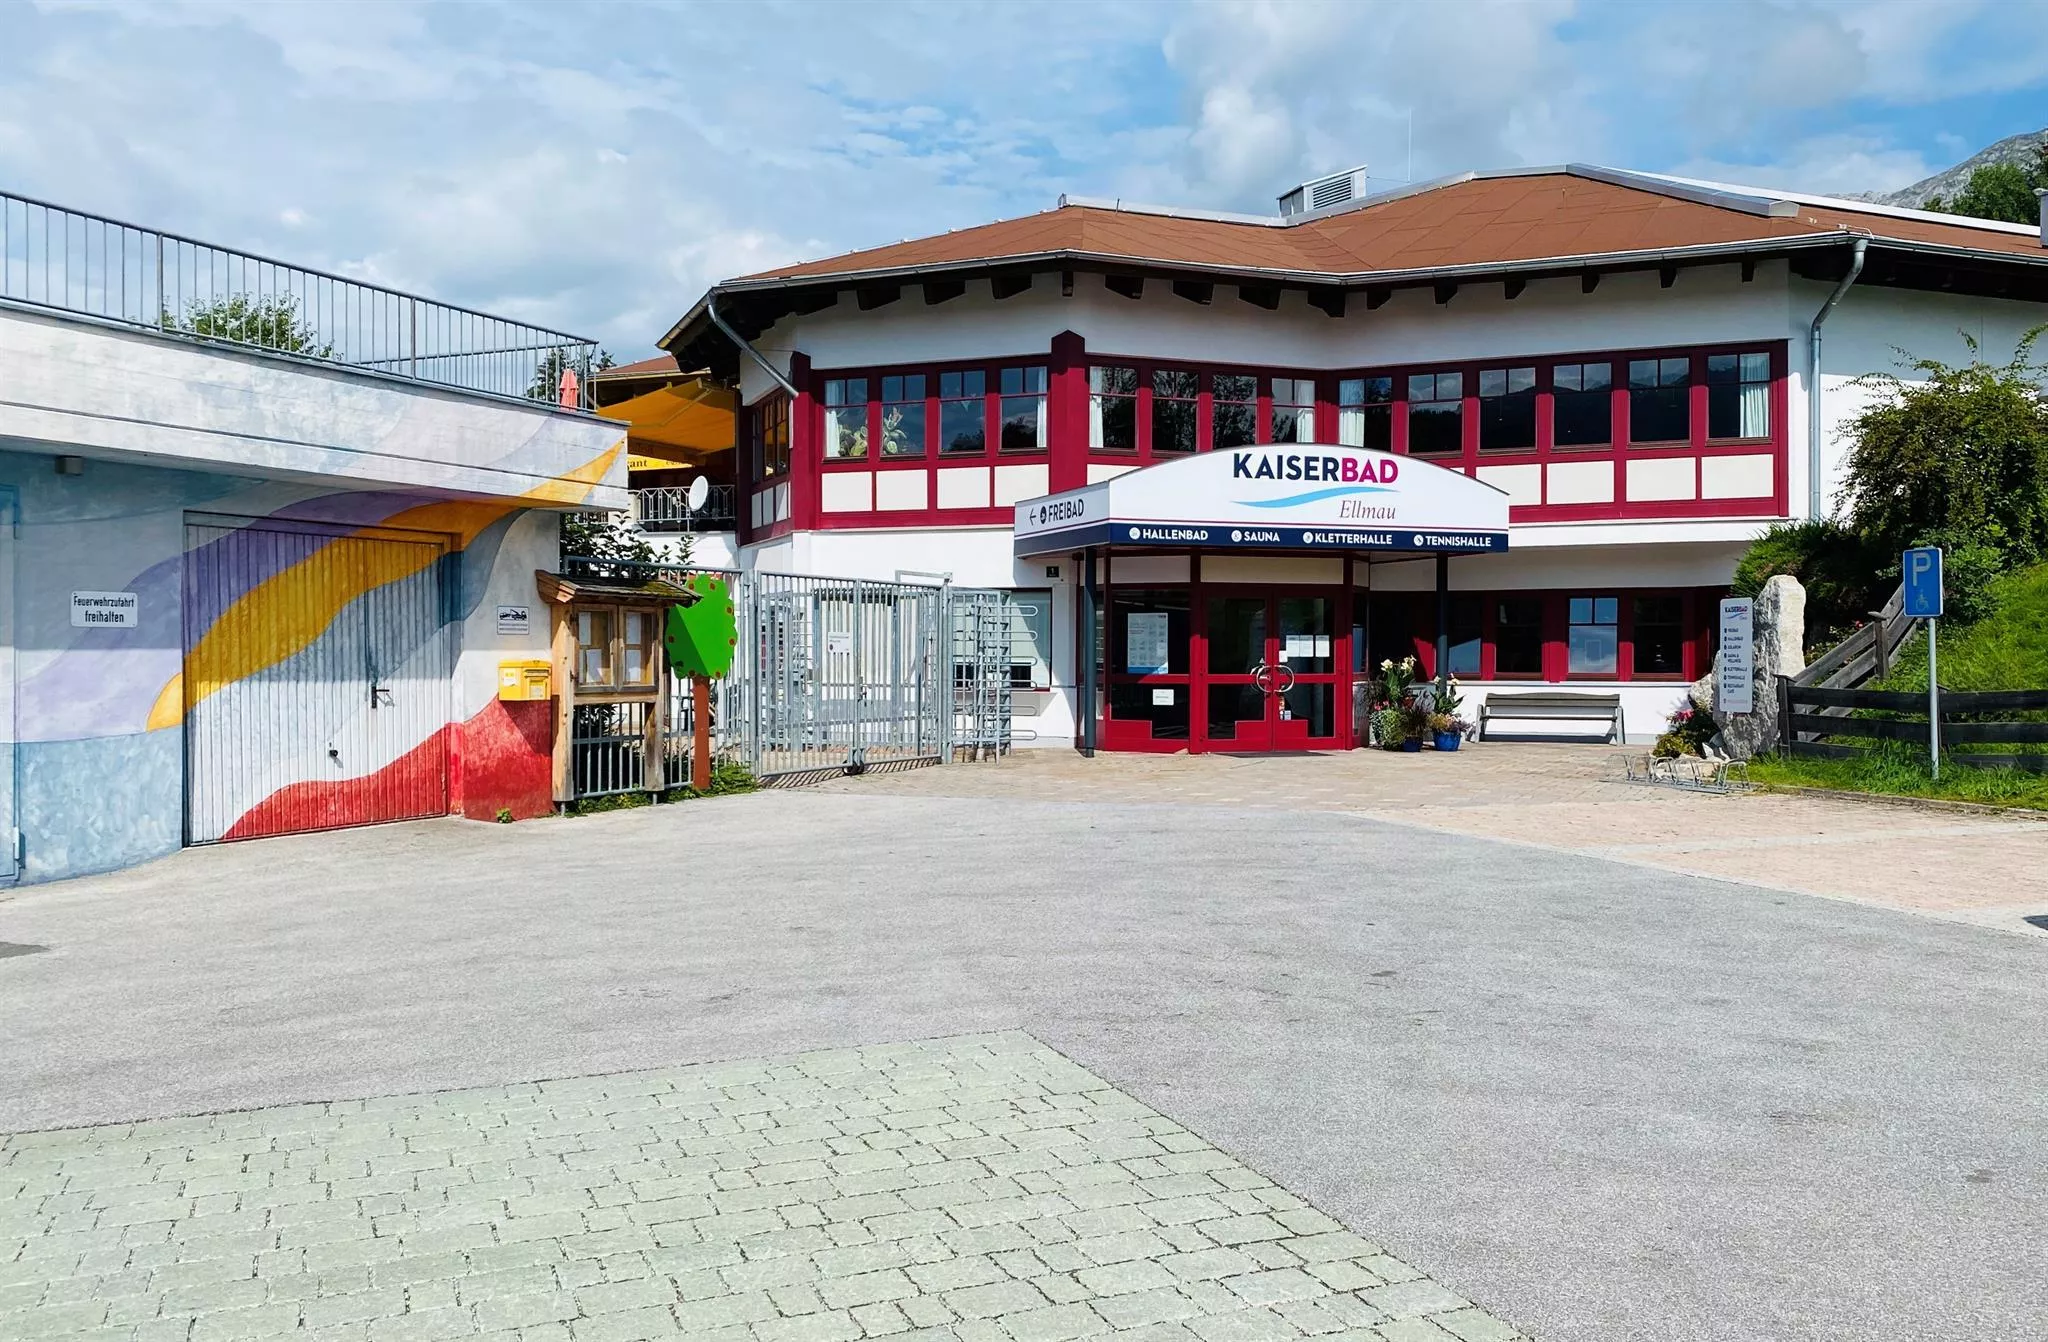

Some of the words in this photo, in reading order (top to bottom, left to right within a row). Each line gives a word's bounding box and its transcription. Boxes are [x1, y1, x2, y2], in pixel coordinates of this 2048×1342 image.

[1233, 453, 1399, 484] KAISERBAD
[1048, 498, 1085, 522] FREIBAD
[1339, 500, 1397, 520] Ellmau
[1142, 528, 1209, 541] HALLENBAD
[1243, 531, 1281, 542] SAUNA
[1314, 532, 1393, 545] KLETTERHALLE
[1425, 535, 1492, 547] TENNISHALLE
[1912, 552, 1932, 587] P
[73, 595, 135, 608] Feuerwehrzufahrt
[85, 610, 125, 623] freihalten
